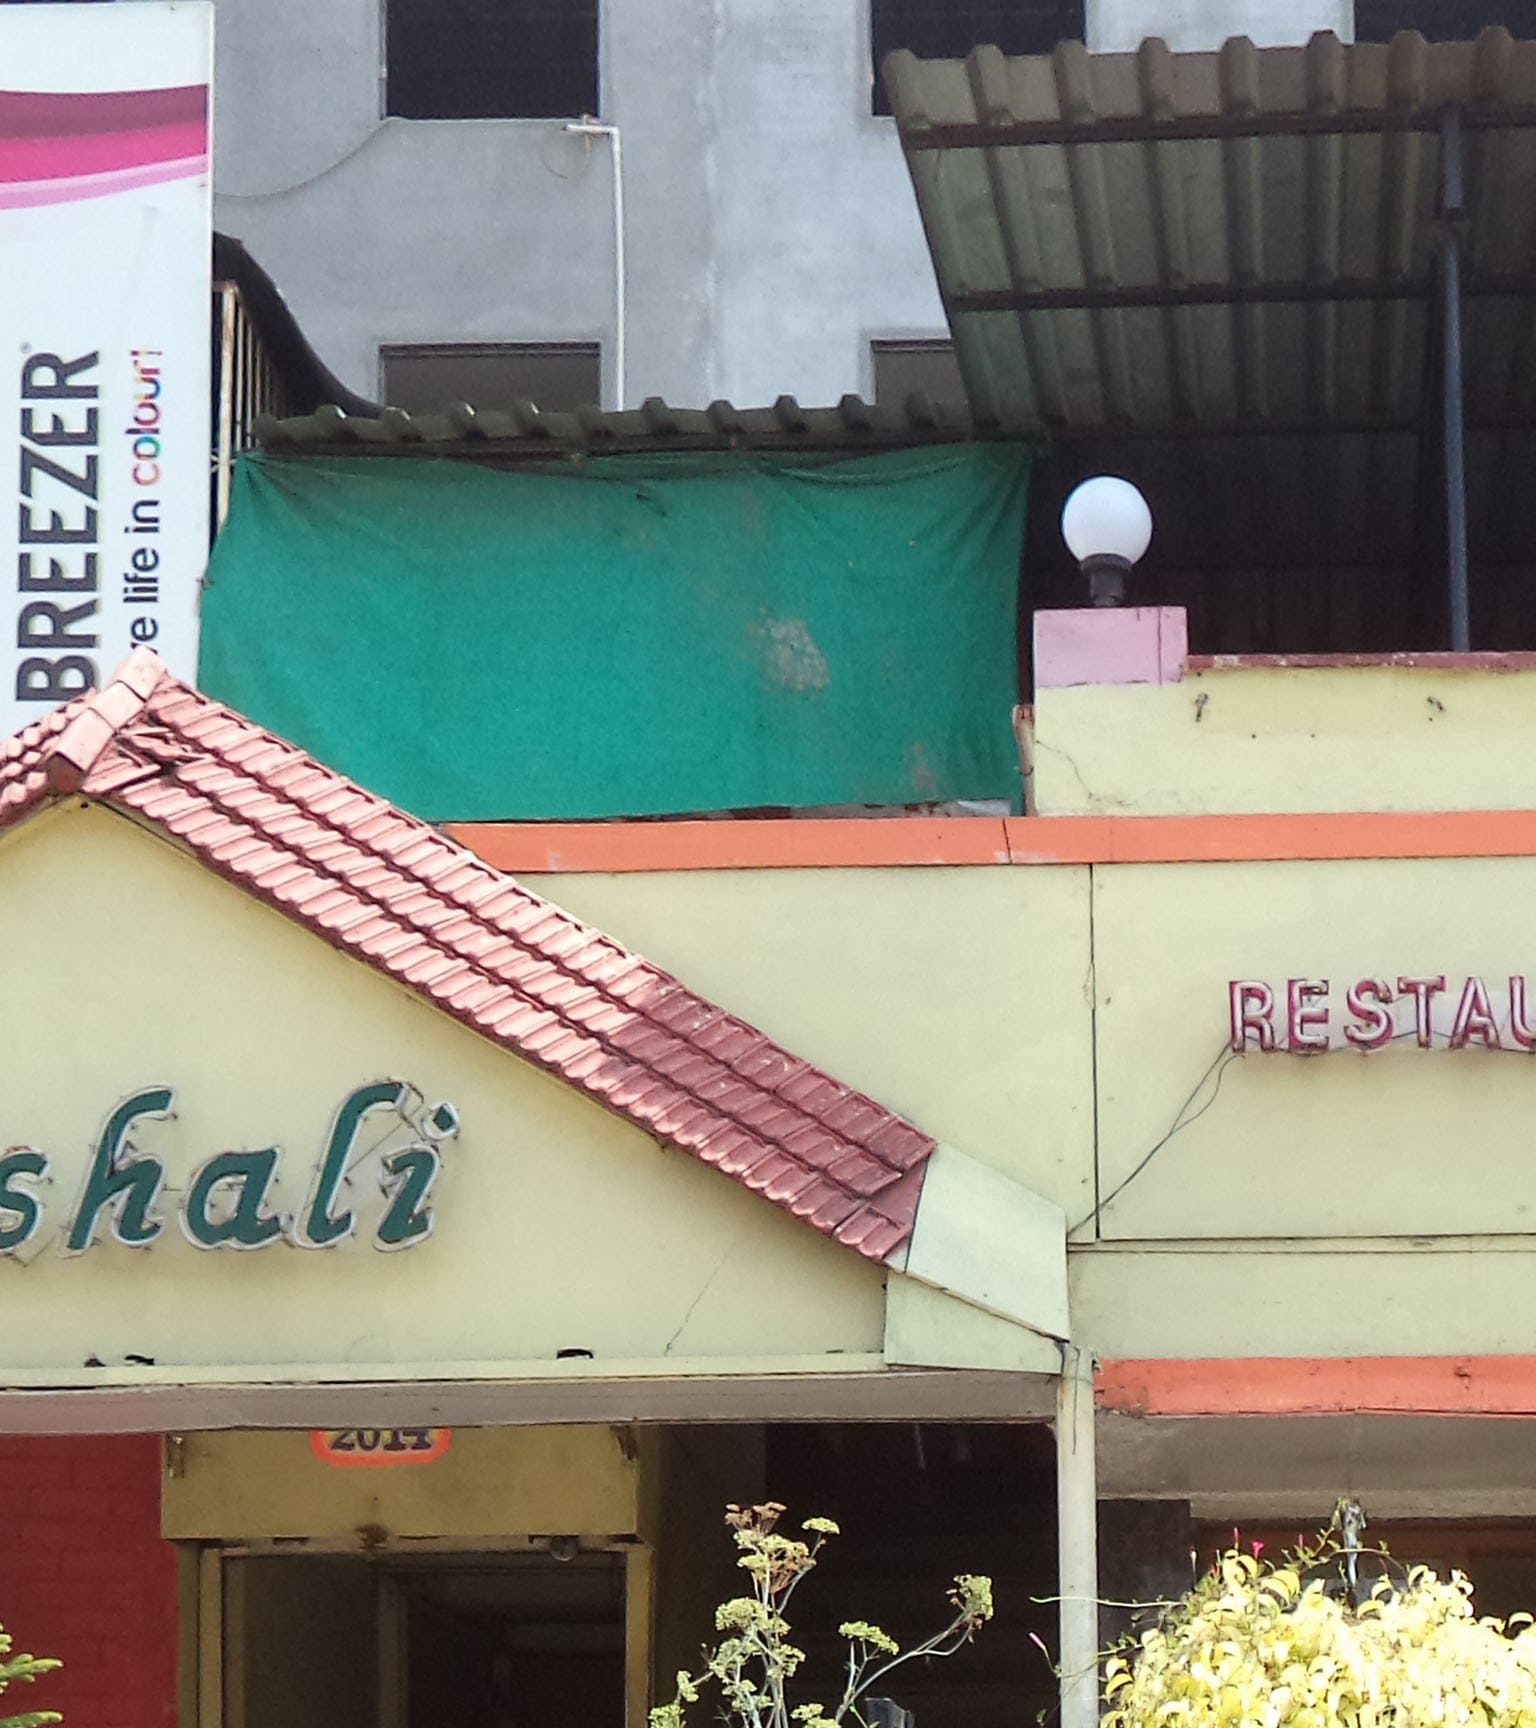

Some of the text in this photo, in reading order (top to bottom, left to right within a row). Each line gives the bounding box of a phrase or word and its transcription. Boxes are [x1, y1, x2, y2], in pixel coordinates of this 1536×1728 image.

[125, 350, 163, 486] colour!
[15, 350, 100, 701] BREEZER
[124, 500, 160, 533] in
[123, 547, 159, 603] life
